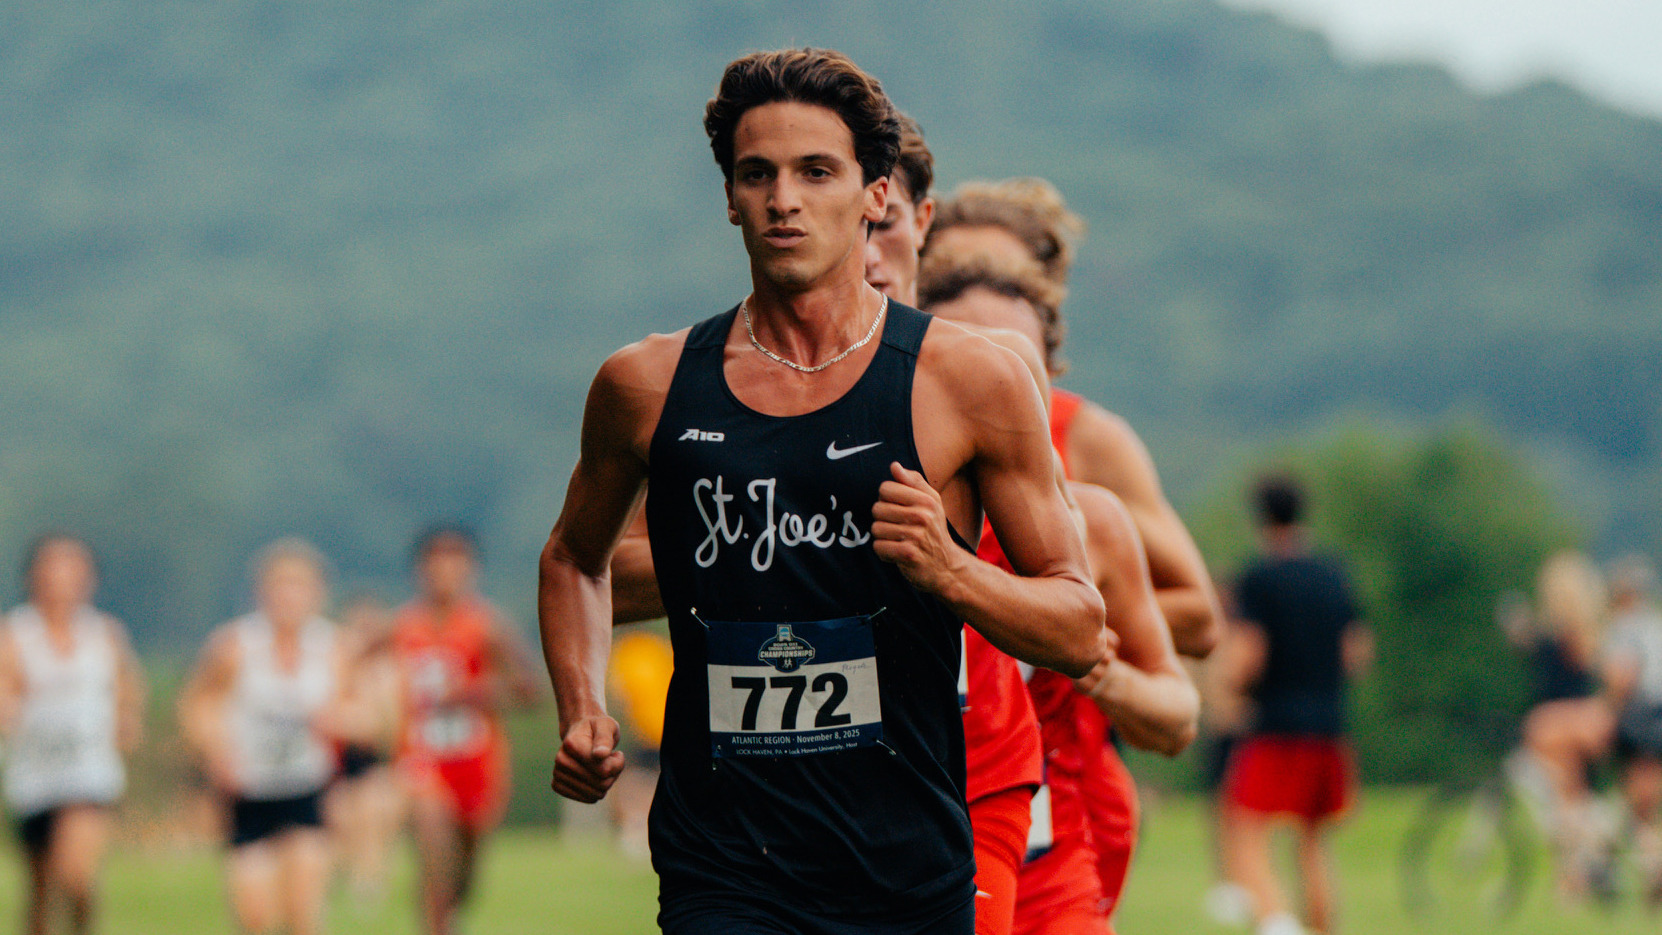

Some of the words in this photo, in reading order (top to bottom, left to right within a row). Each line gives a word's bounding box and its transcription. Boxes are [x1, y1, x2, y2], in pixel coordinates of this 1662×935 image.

[678, 428, 725, 442] A10
[747, 477, 871, 571] Joe's
[760, 649, 813, 658] CHAMPIONSHIPS
[731, 672, 852, 731] 772
[732, 735, 763, 745] ATLANTIC
[764, 735, 791, 745] REGION
[796, 733, 833, 743] November
[834, 731, 842, 740] 8,
[843, 728, 860, 739] 2025
